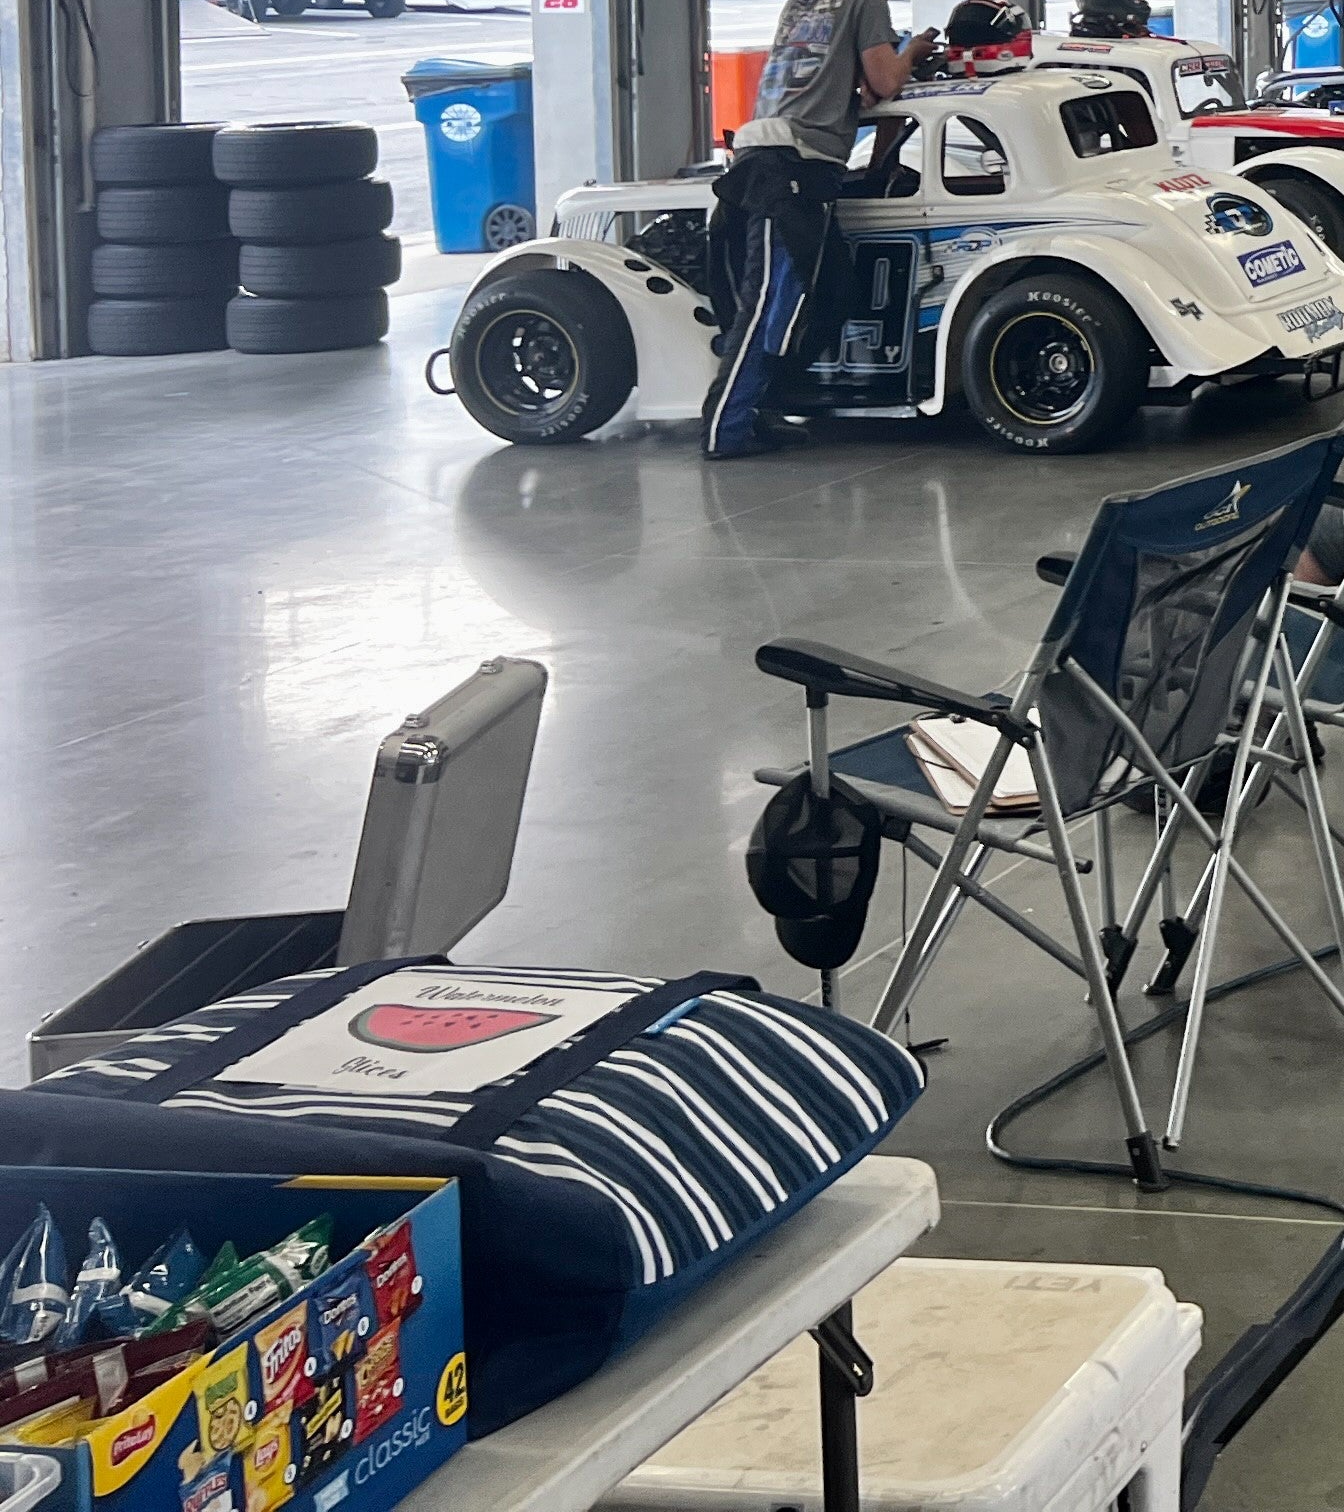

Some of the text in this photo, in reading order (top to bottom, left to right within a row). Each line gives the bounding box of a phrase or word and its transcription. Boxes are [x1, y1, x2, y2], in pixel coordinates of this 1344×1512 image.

[1244, 243, 1299, 281] COMETIC
[415, 985, 566, 1007] Watermelon
[332, 1055, 408, 1079] Slices
[445, 1361, 466, 1402] 42
[355, 1406, 431, 1485] classic
